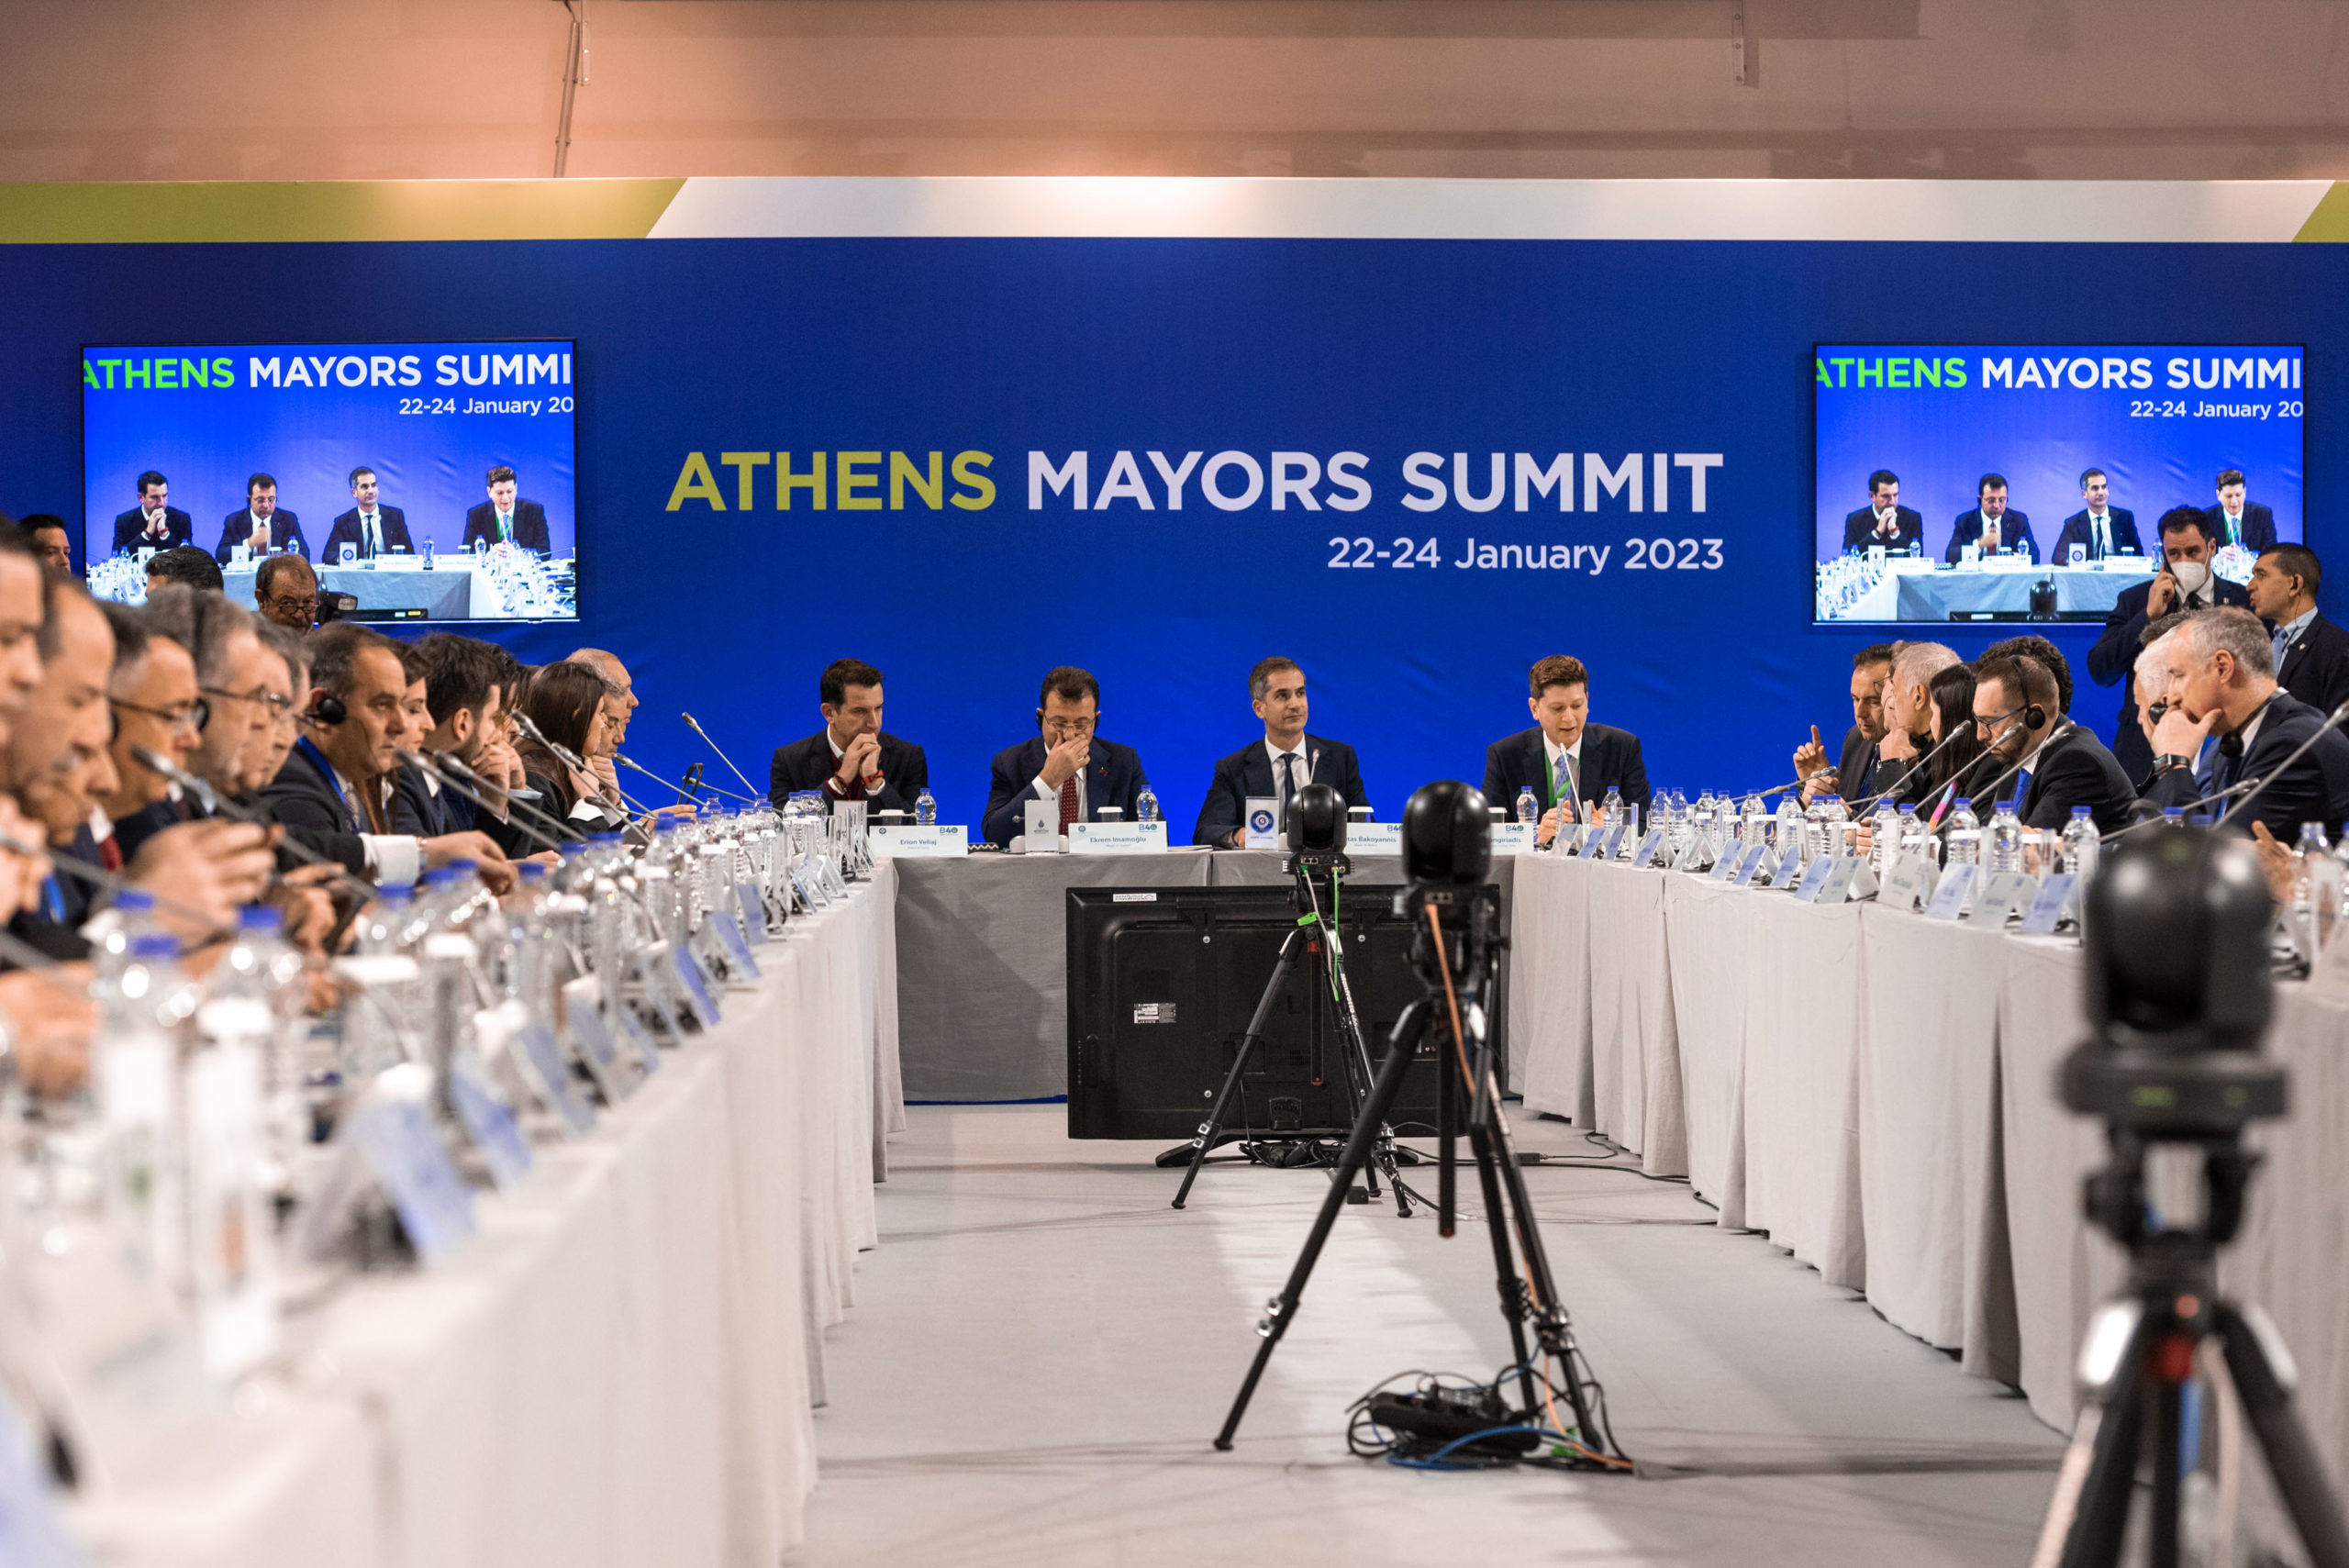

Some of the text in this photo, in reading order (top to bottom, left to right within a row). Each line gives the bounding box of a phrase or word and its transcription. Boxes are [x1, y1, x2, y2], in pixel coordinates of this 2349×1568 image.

[83, 353, 571, 390] ATHENS MAYORS SUMMI
[1816, 356, 2301, 390] ATHENS MAYORS SUMMI
[399, 396, 574, 417] 22-24 January 20
[2130, 400, 2304, 420] 22-24 January 20
[666, 450, 1724, 513] ATHENS MAYORS SUMMIT
[1328, 537, 1724, 576] 22-24 January 2023
[1358, 836, 1397, 844] Bakoyannis
